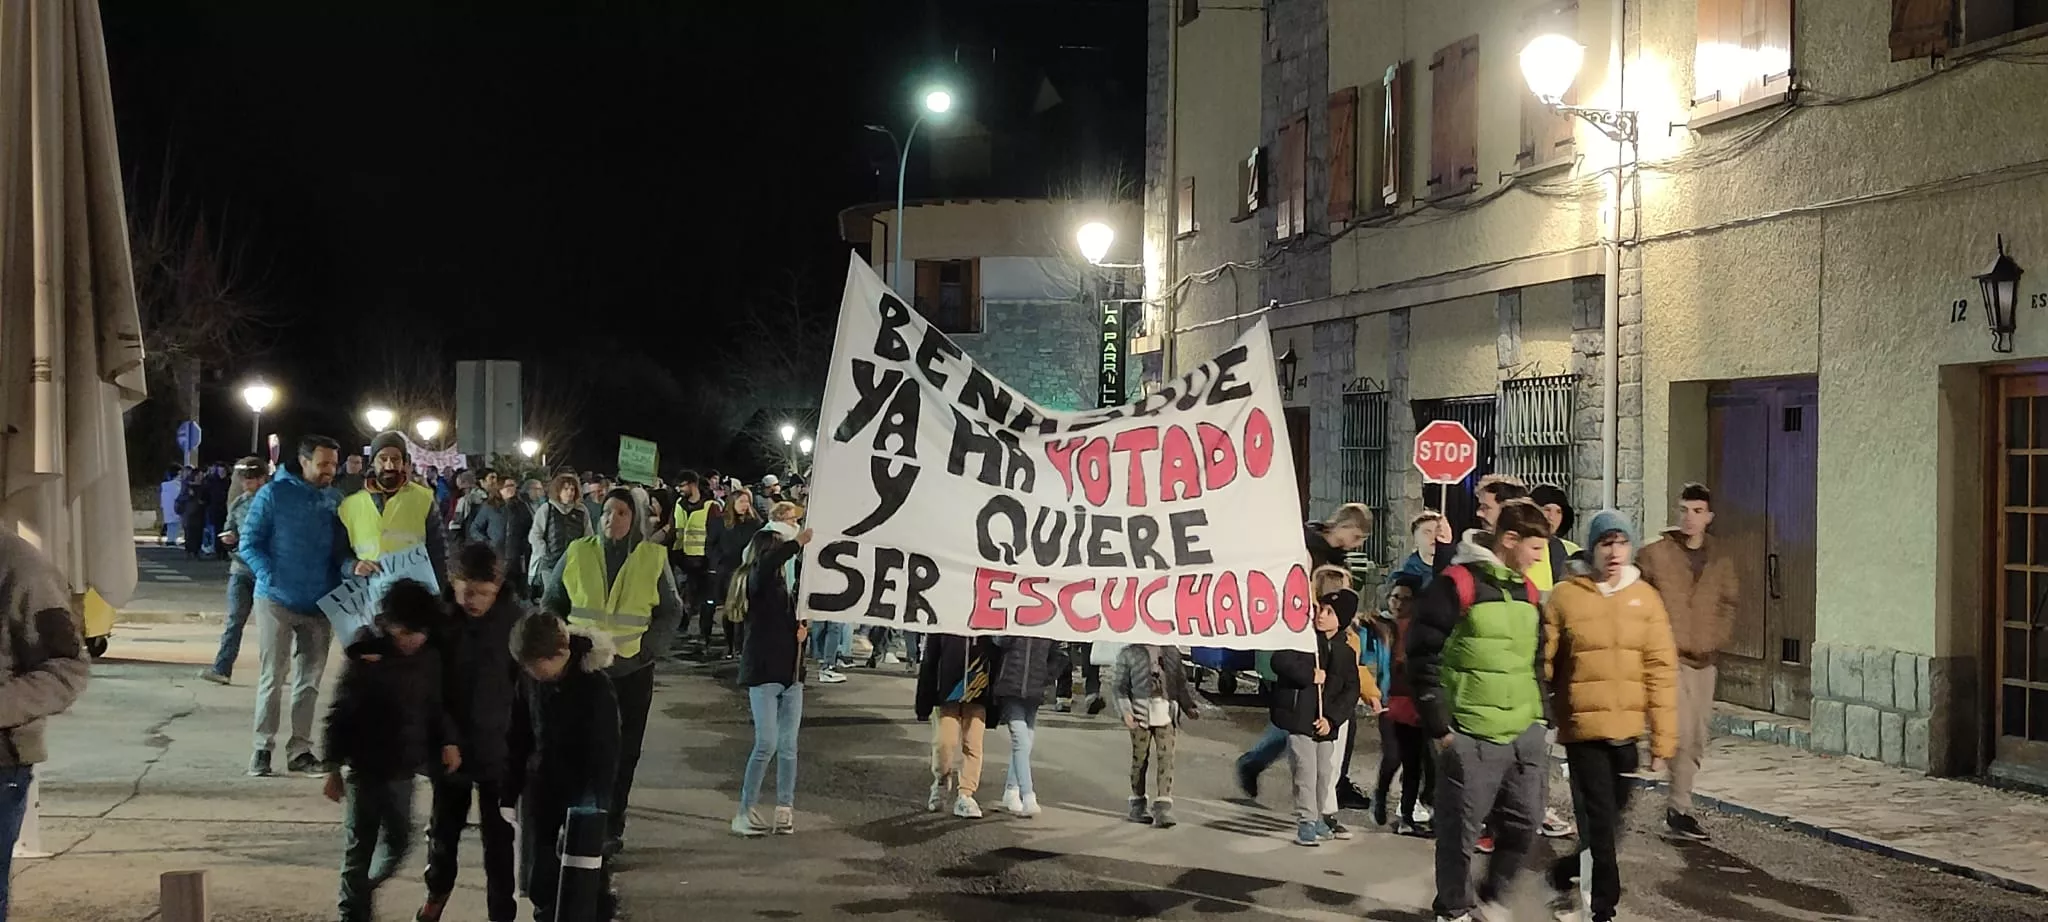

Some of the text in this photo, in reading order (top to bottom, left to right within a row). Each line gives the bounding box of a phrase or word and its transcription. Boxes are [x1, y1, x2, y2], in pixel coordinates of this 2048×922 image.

[1104, 305, 1118, 325] LA
[1951, 299, 1968, 323] 12
[833, 358, 921, 459] YA
[948, 403, 1036, 493] HA
[1419, 440, 1472, 463] STOP
[842, 455, 1214, 570] Y QUIERE
[808, 541, 1312, 636] SER ESCUCHADO
